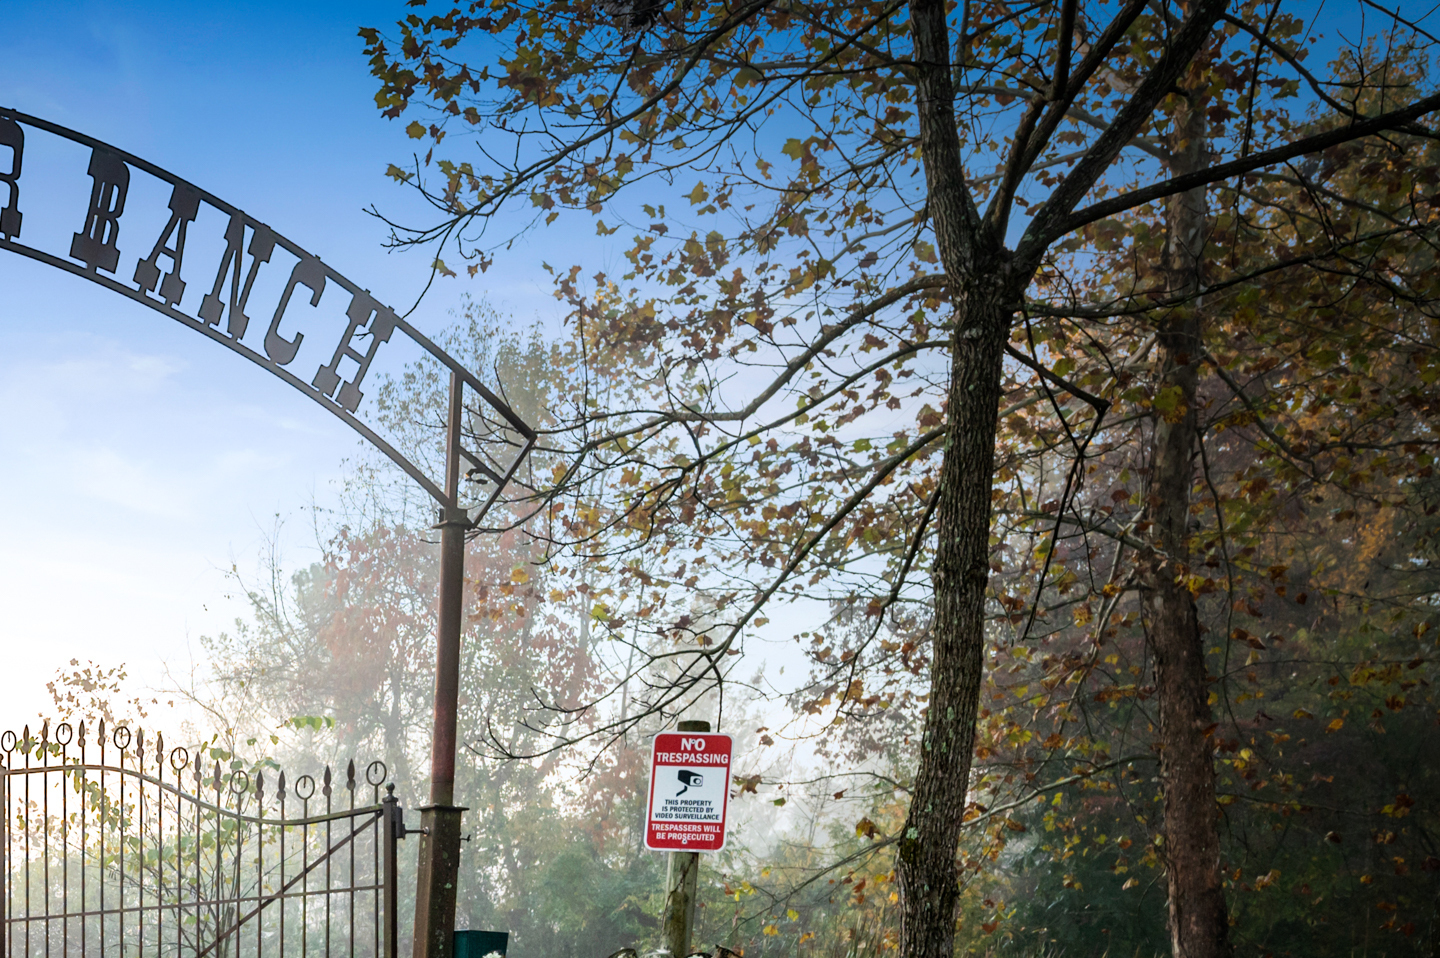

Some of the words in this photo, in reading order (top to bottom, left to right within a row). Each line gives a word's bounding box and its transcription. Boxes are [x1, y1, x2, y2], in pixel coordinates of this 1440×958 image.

[69, 146, 397, 415] RANCH
[681, 738, 706, 752] NO
[656, 752, 729, 764] TRESPASSING
[651, 823, 702, 832] TRESPASSERS
[703, 825, 721, 833] WILL
[656, 832, 666, 840] BE
